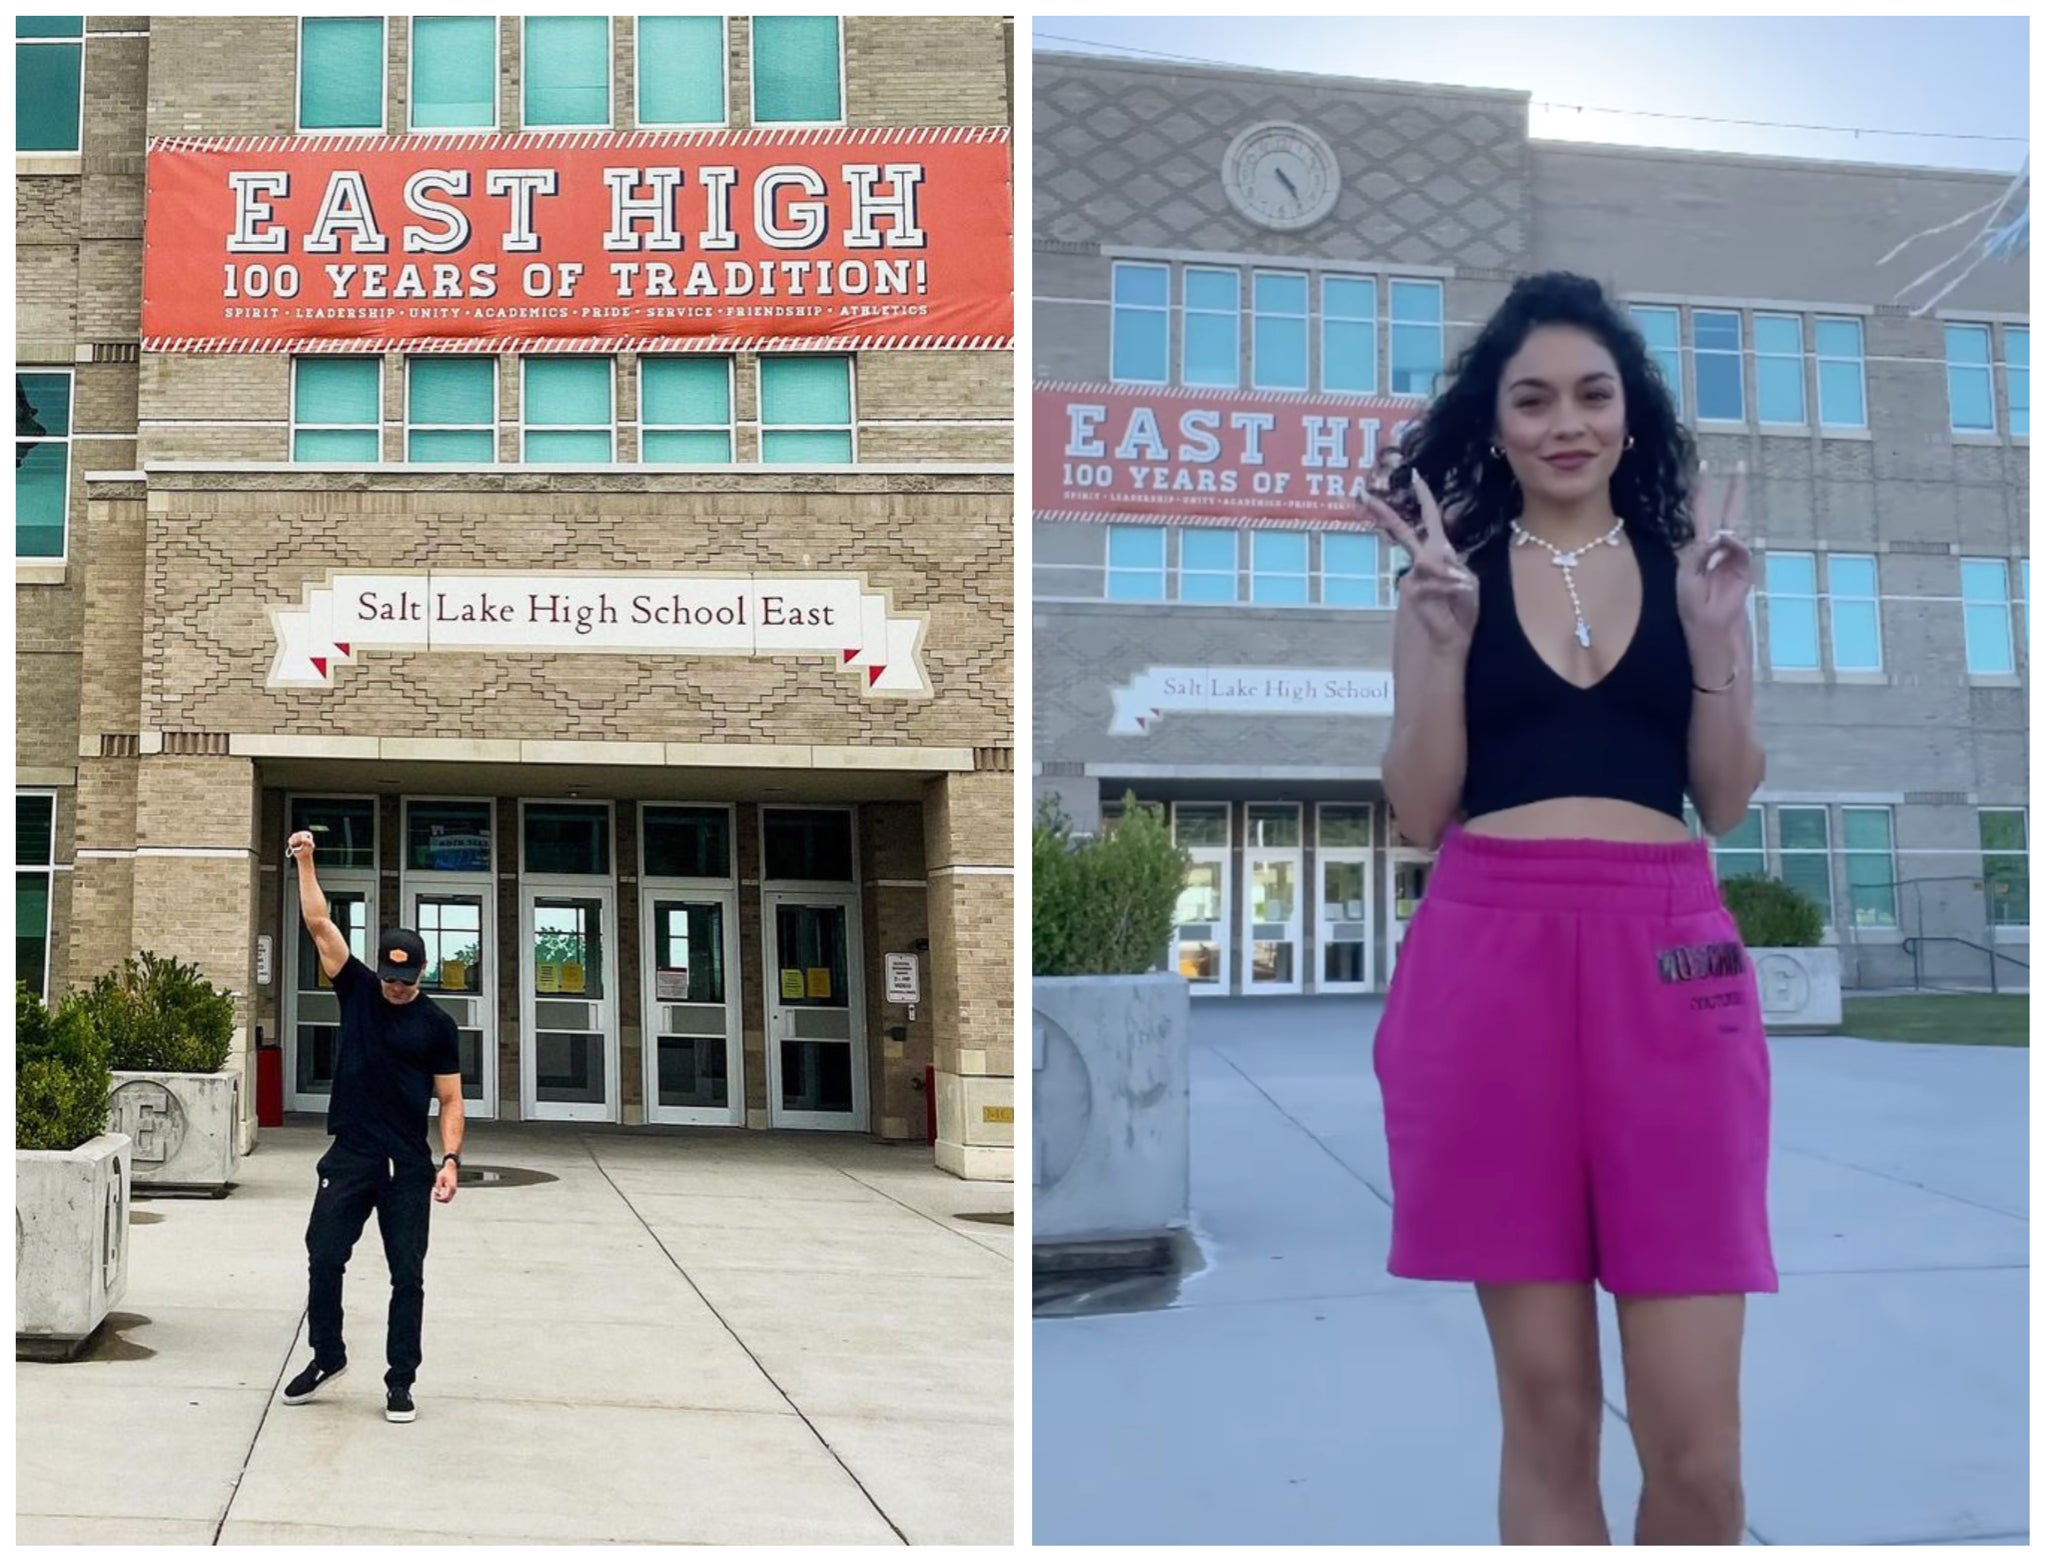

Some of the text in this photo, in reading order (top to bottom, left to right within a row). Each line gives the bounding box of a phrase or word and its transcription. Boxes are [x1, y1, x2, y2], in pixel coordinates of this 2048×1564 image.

[226, 163, 928, 254] EAST HIGH
[222, 259, 929, 300] 100 YEARS OF TRADITION!
[224, 304, 929, 319] SPIRIT LEADERSHIP UNITY ACADEMICS PRIDE SERVICE FRIENDSHIP ATHLETICS
[1064, 403, 1275, 467] EAST
[1063, 464, 1113, 488] 100
[1129, 468, 1239, 494] YEARS
[1252, 472, 1291, 495] OF
[357, 591, 835, 635] Salt Lake High School East
[1163, 678, 1389, 704] Salt Lake High School
